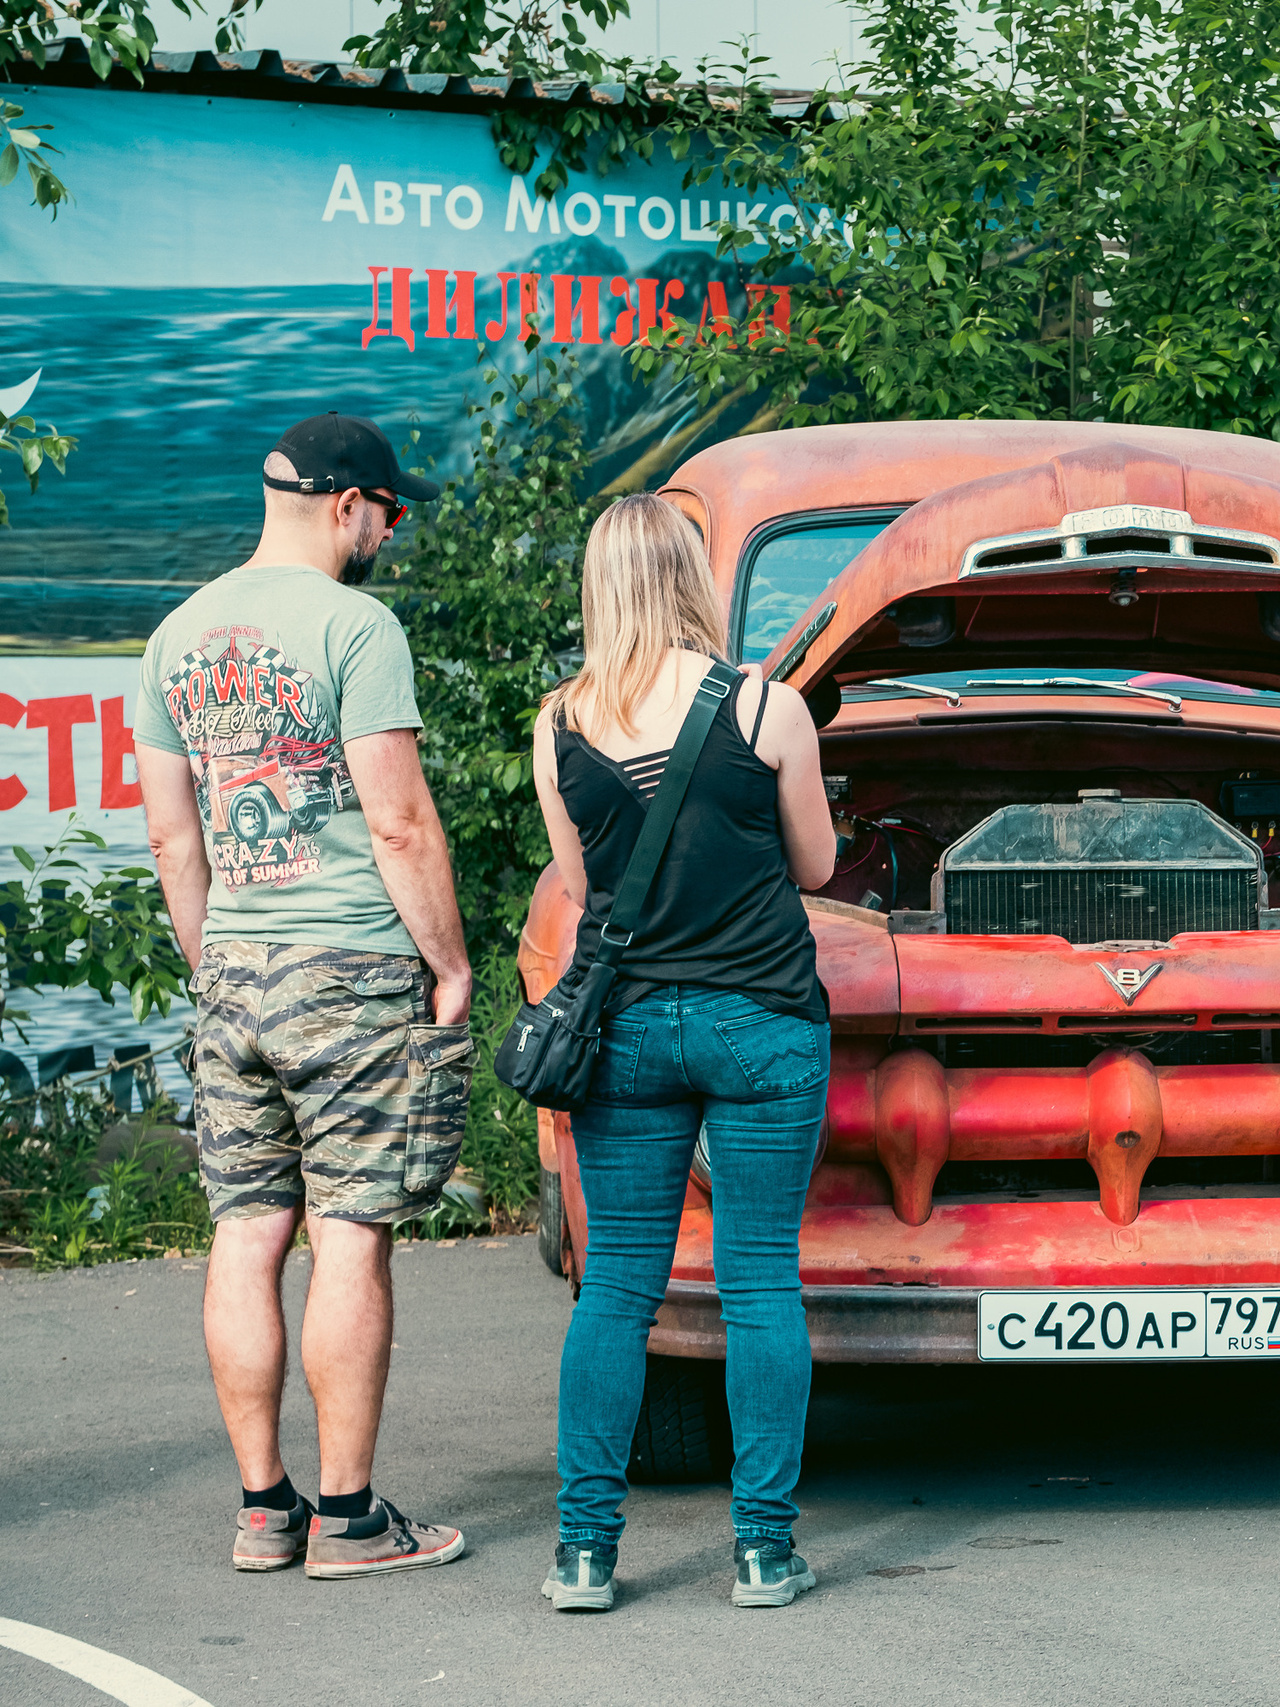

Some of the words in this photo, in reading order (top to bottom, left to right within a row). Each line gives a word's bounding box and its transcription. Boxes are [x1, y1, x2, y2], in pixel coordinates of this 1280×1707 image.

[505, 174, 864, 251] Мотошкол
[361, 266, 842, 353] ДИЛИЖАН
[1072, 506, 1186, 532] FORD
[164, 659, 313, 729] POWER
[230, 703, 287, 732] Meet
[213, 835, 299, 870] CRAZY
[232, 867, 249, 886] OF
[250, 857, 322, 884] SUMMER
[1228, 1337, 1265, 1351] RUS
